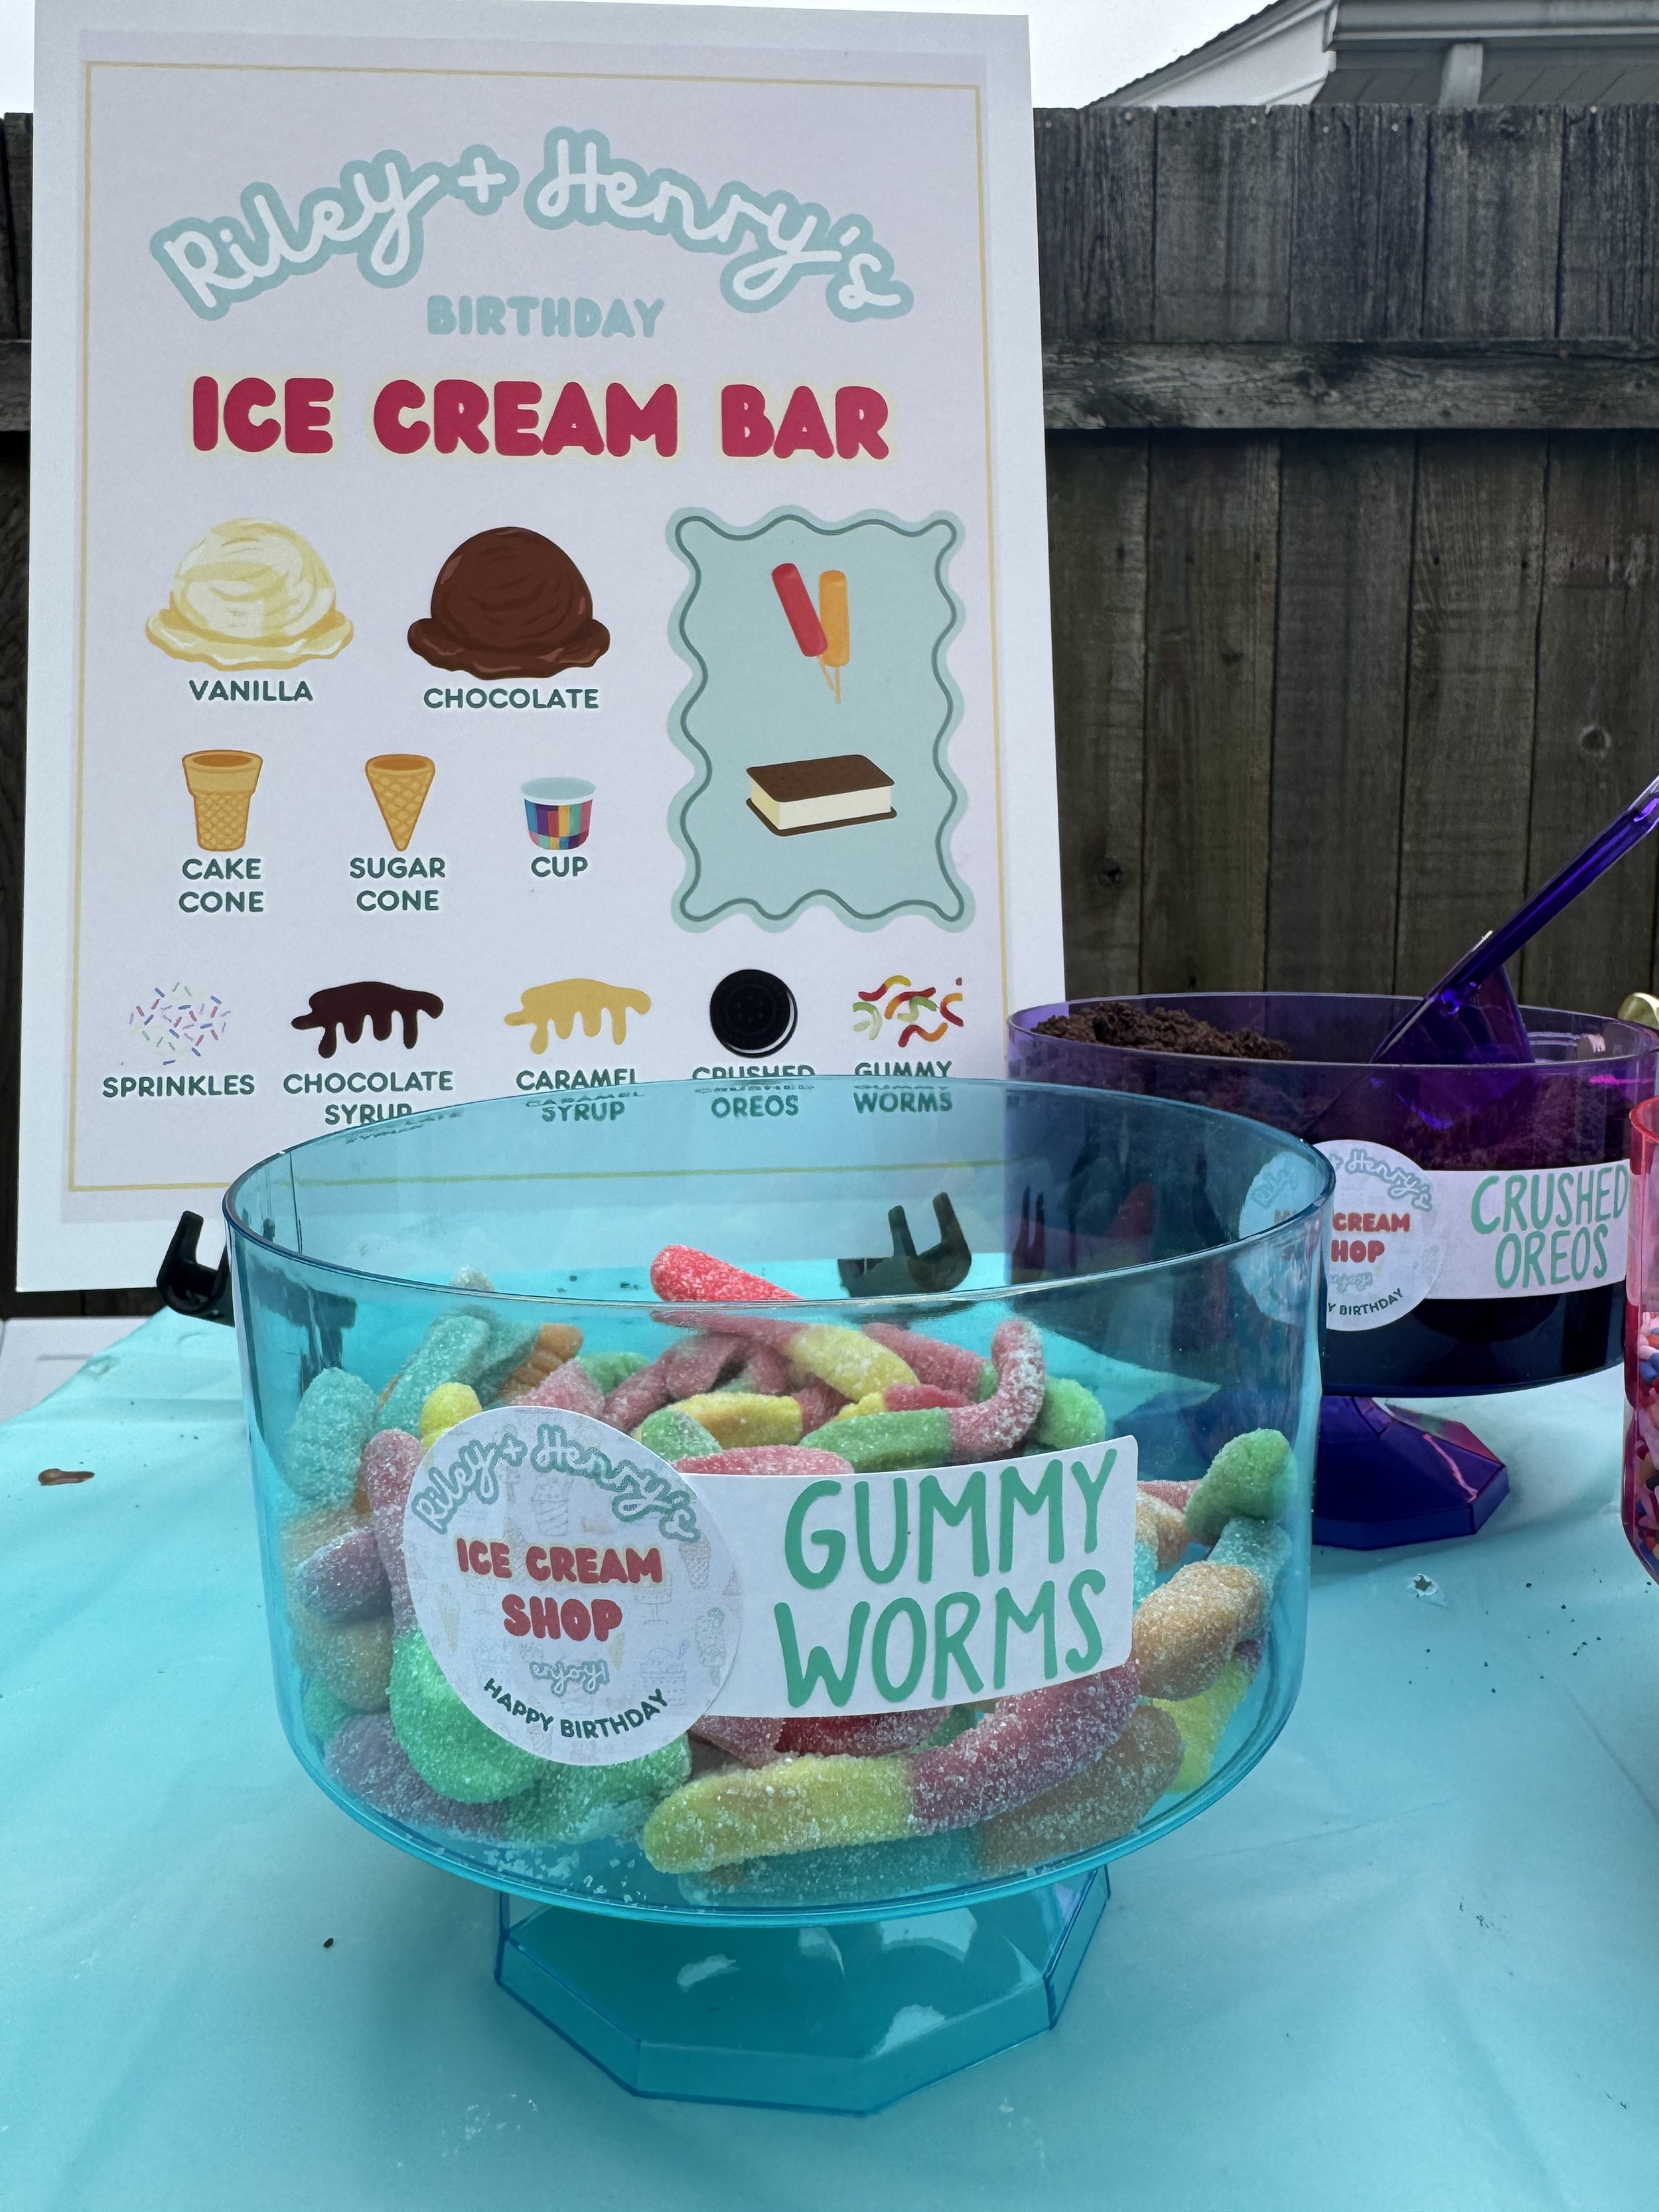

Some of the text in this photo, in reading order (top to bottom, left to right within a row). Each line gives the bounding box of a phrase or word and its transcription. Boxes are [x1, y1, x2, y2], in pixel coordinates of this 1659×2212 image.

[155, 131, 909, 318] Riley + Henry's
[427, 295, 663, 338] BIRTHDAY
[192, 376, 889, 459] ICE CREAM BAR
[189, 680, 313, 702] VANILLA
[423, 688, 599, 709] CHOCOLATE
[182, 858, 261, 880] CAKE
[350, 857, 446, 879] SUGAR
[531, 855, 589, 878] CUP
[179, 891, 263, 913] CONE
[356, 889, 439, 912] CONE
[516, 1069, 637, 1090] CARAMEL
[855, 1061, 952, 1078] GUMMY
[102, 1074, 255, 1098] SPRINKLES
[283, 1070, 453, 1094] CHOCOLATE
[325, 1103, 413, 1126] SYRUP
[542, 1100, 625, 1122] SYRUP
[711, 1095, 798, 1118] OREOS
[854, 1092, 953, 1114] WORMS
[1471, 1165, 1628, 1234] CRUSHED
[1333, 1213, 1410, 1232] CREAM
[1331, 1240, 1385, 1263] HOP
[1495, 1223, 1609, 1290] OREOS
[1339, 1288, 1403, 1315] BIRTHDAY
[411, 1439, 499, 1533] Riley
[531, 1424, 700, 1543] Henry's
[784, 1448, 1117, 1590] GUMMY
[457, 1538, 662, 1584] ICE CREAM
[502, 1594, 622, 1641] SHOP
[774, 1569, 1106, 1708] WORMS
[484, 1678, 668, 1739] HAPPY BIRTHDAY
